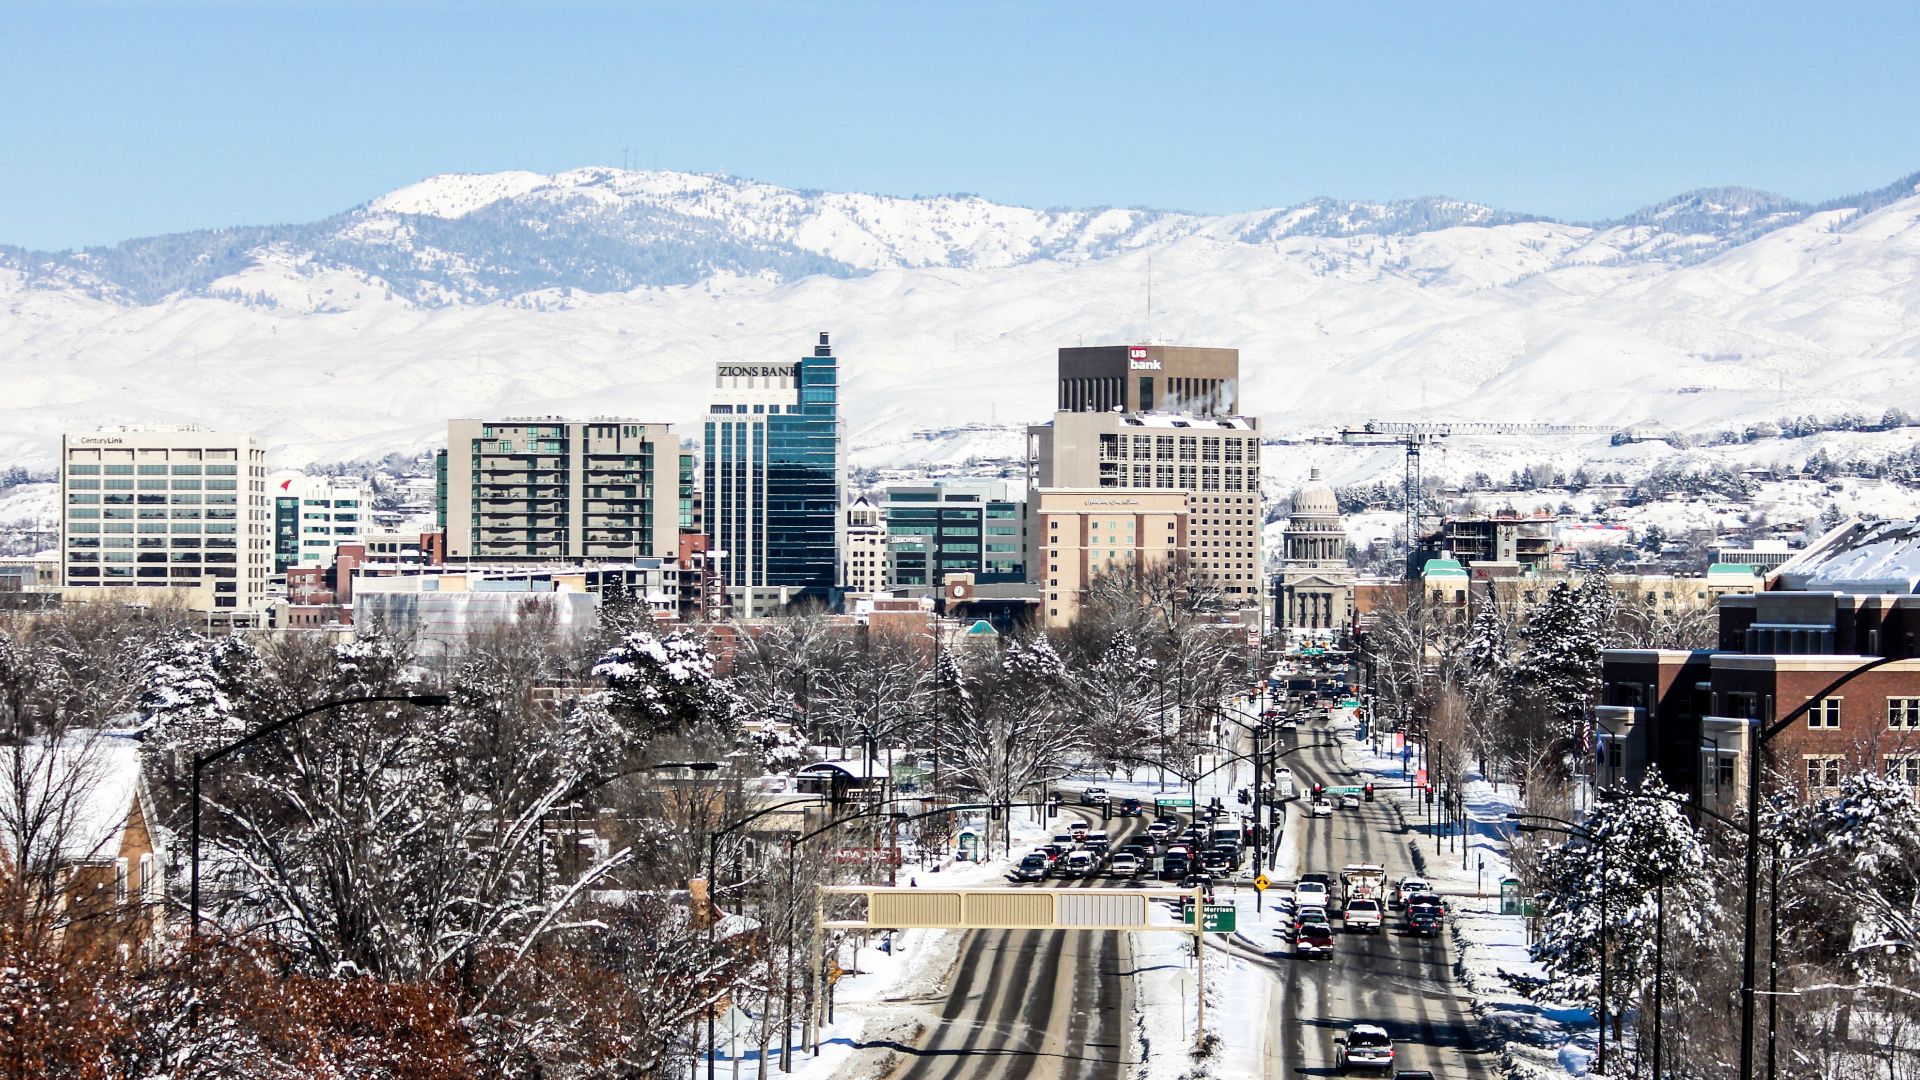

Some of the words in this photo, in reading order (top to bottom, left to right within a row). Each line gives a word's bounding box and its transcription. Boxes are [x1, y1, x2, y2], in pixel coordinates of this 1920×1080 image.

[1131, 349, 1147, 358] us
[1130, 359, 1162, 370] bank
[718, 366, 758, 377] ZIONS
[80, 436, 123, 444] CenturyLink
